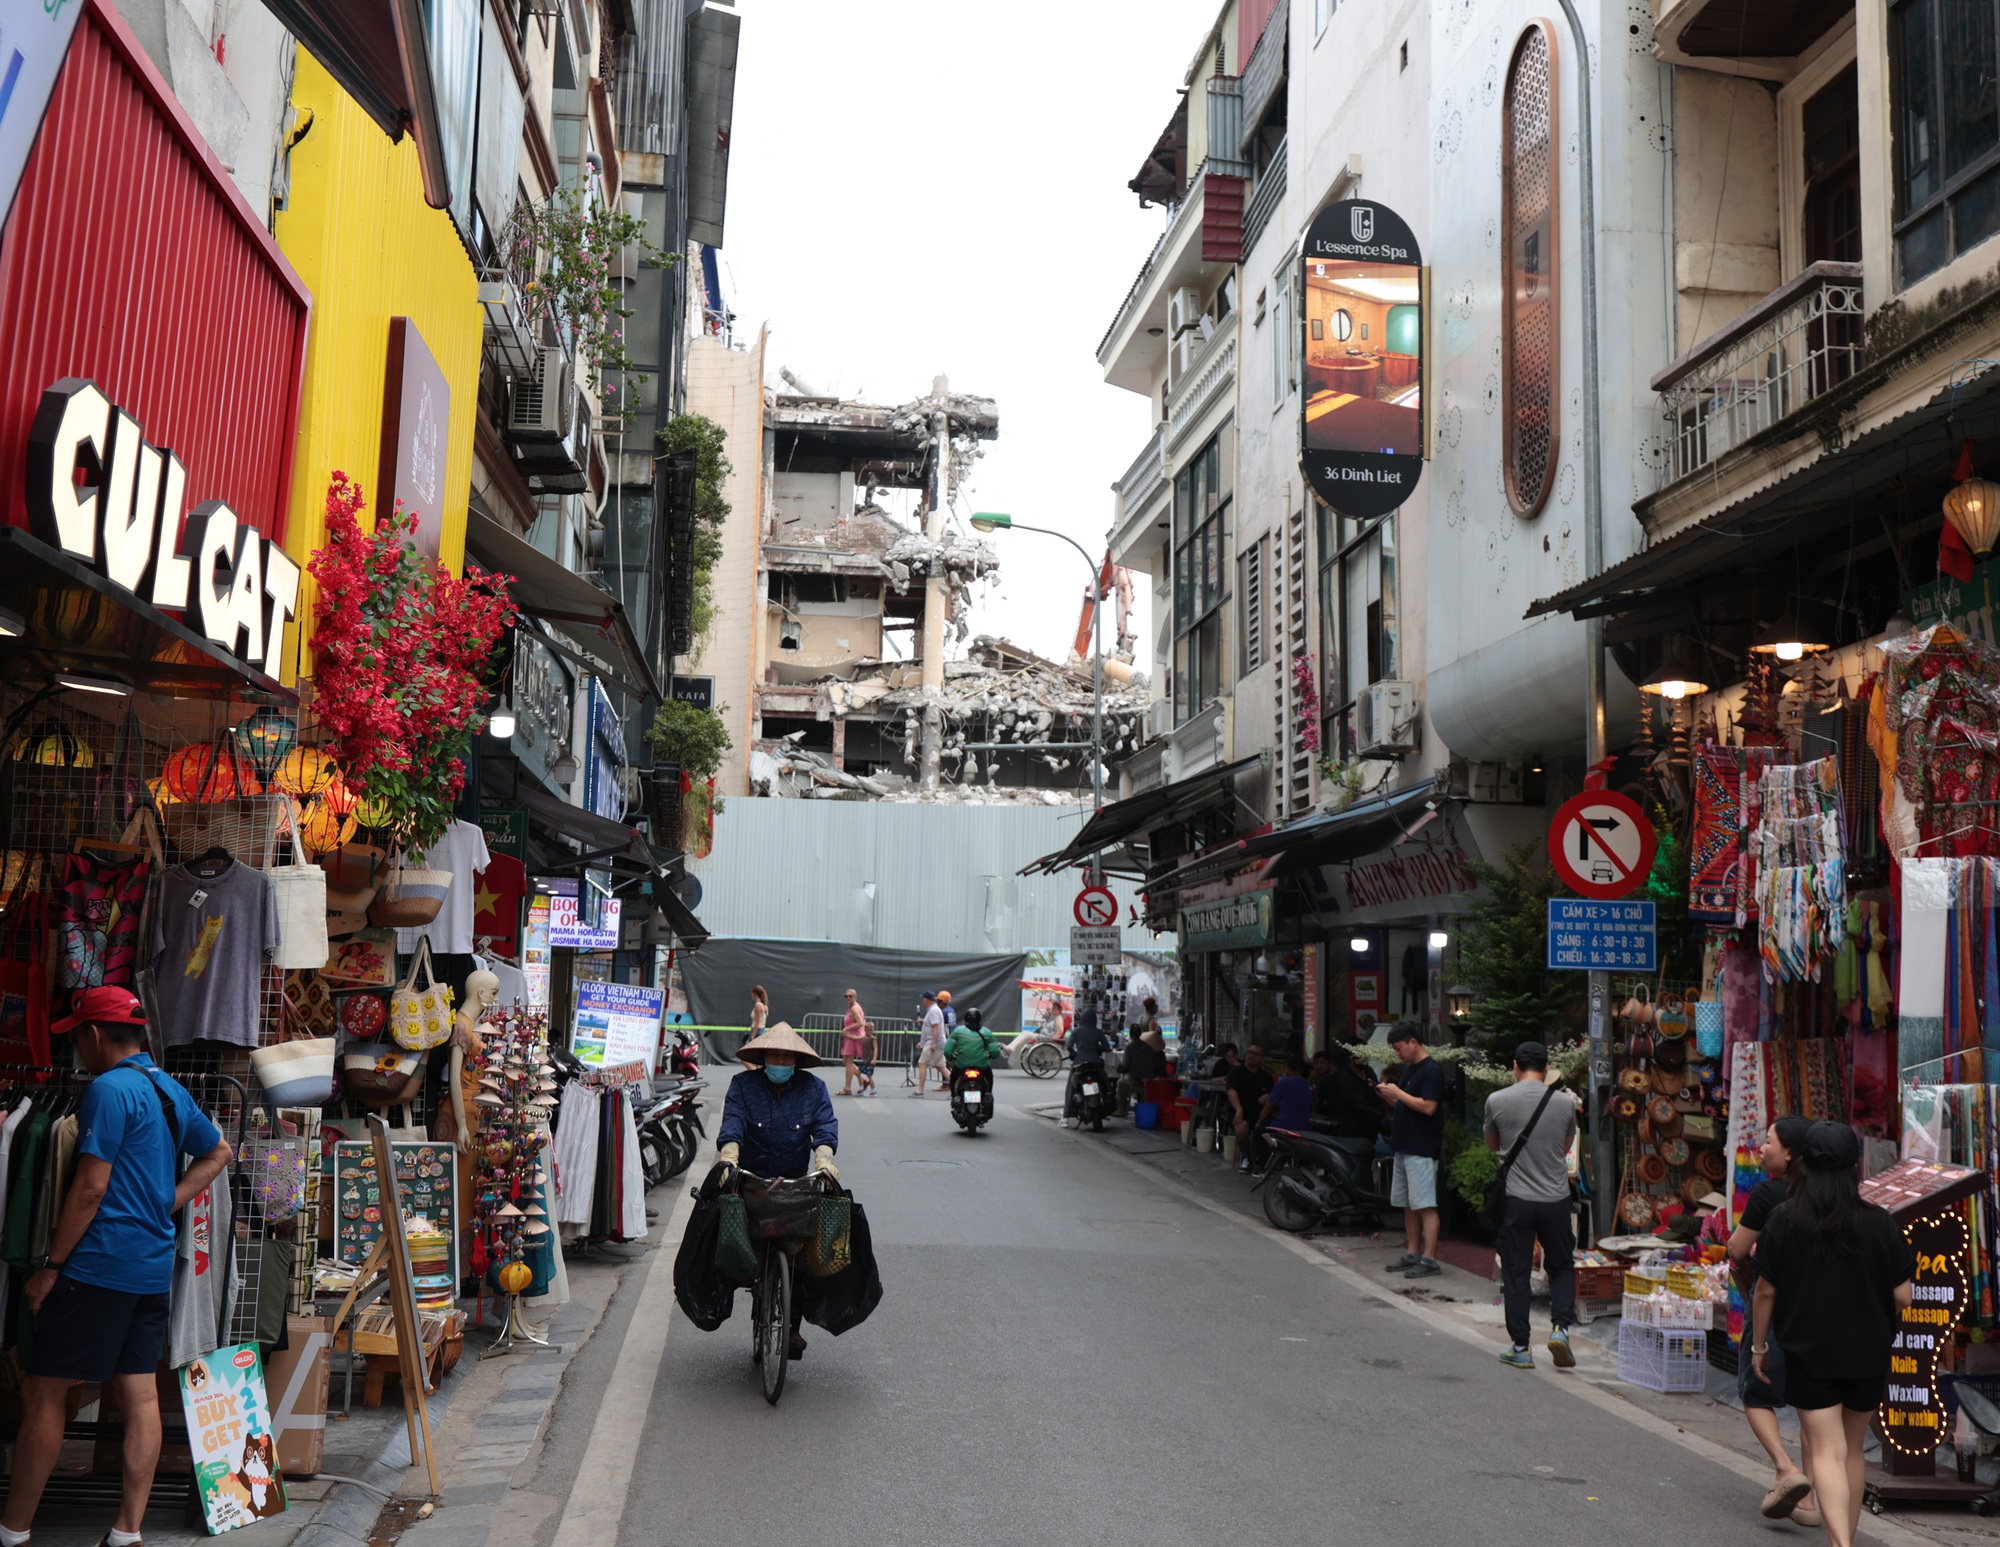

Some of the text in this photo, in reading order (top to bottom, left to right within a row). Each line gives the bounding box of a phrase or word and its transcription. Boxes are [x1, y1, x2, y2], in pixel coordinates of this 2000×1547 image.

[1316, 240, 1407, 259] L'essence Spa
[1325, 467, 1402, 483] 36 Dinh Liet
[38, 380, 301, 683] CULCAT
[1563, 902, 1582, 918] CẤM
[1586, 906, 1598, 918] XE
[1611, 907, 1620, 919] 16
[551, 927, 616, 937] MAMA HOMESTAY
[1557, 932, 1585, 946] SÁNG:
[550, 937, 581, 945] JASMINE
[595, 939, 616, 947] GIANG
[582, 982, 661, 1001] KLOOK VIETNAM TOUR
[607, 995, 626, 1004] YOUR
[628, 998, 649, 1006] GUIDE
[582, 1000, 610, 1008] MONEY
[612, 1003, 656, 1015] EXCHANGE
[1902, 1306, 1950, 1326] Massage
[1907, 1334, 1934, 1349] care
[1891, 1356, 1918, 1374] Nails
[1889, 1384, 1929, 1405] Waxing
[196, 1386, 257, 1428] BUY 2
[1889, 1408, 1938, 1430] Hair washing
[202, 1412, 263, 1453] GET 1
